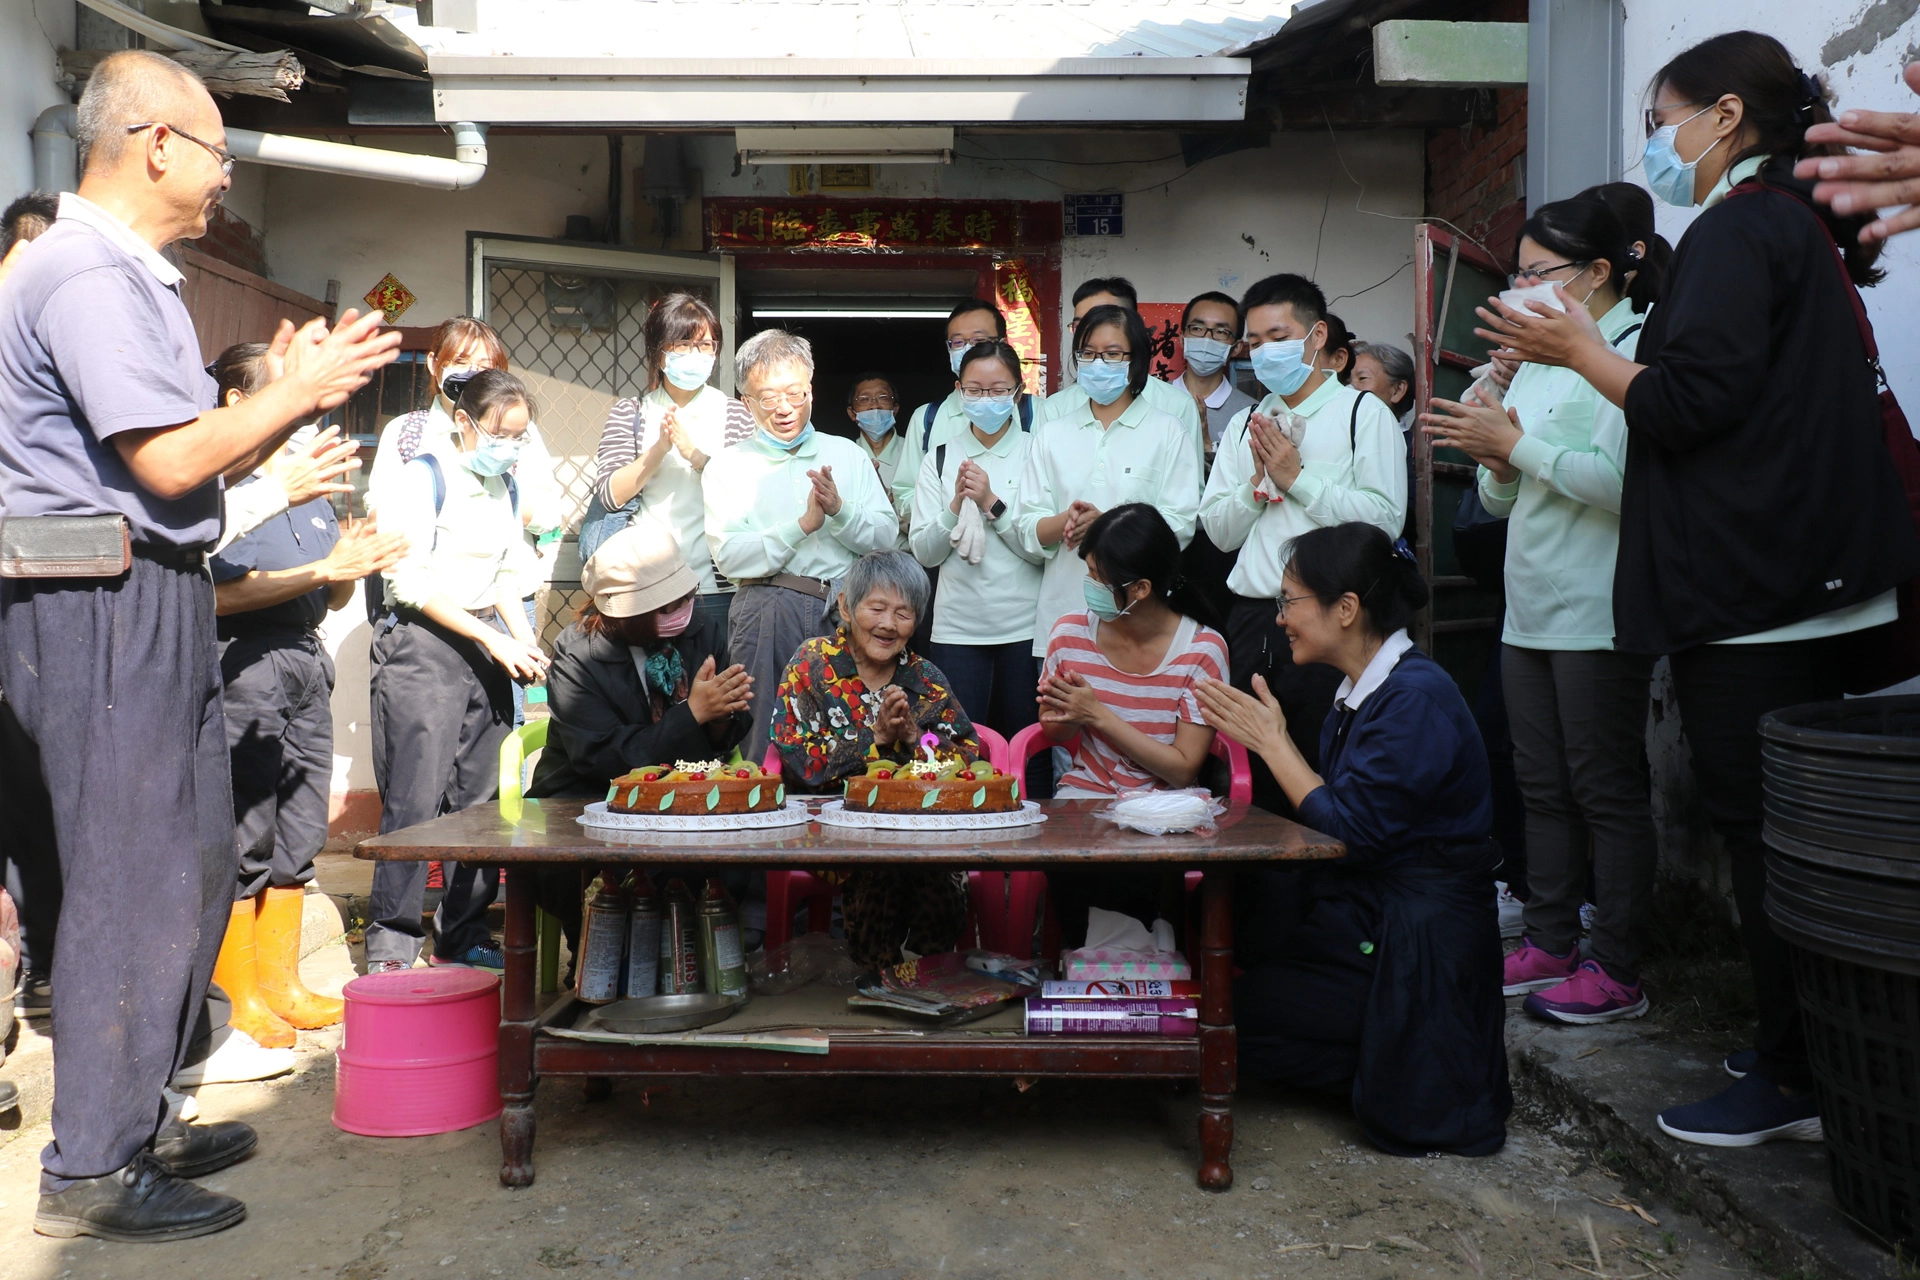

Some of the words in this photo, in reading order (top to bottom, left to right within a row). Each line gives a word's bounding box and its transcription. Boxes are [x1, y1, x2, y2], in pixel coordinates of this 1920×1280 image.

[1078, 195, 1119, 205] 大林路
[1093, 218, 1110, 235] 15
